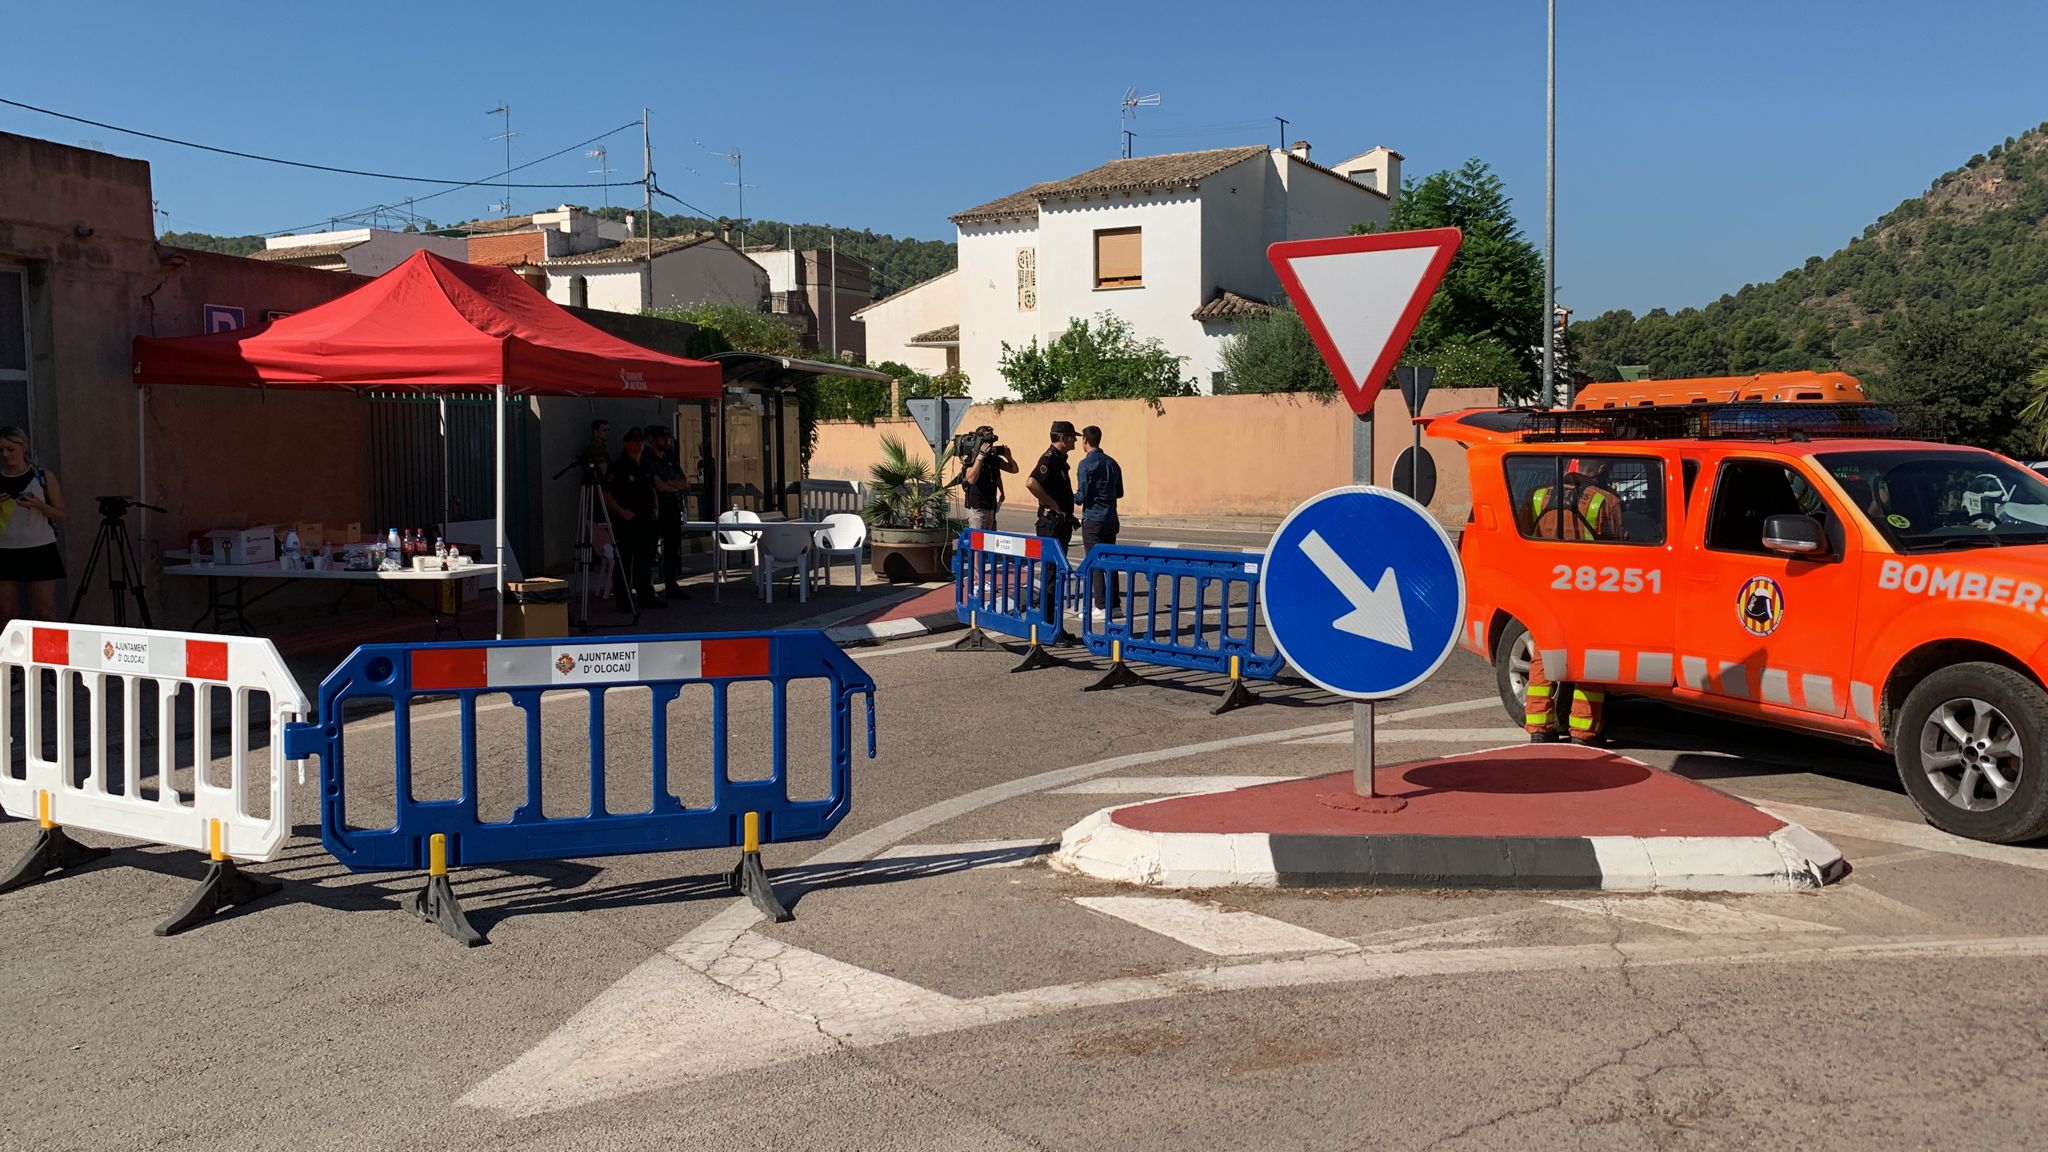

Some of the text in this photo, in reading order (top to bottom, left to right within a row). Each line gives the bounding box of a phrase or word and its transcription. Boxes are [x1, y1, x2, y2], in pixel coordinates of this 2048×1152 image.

[1551, 564, 1661, 594] 28251
[115, 642, 147, 652] AJUNTAMENT
[578, 651, 636, 662] AJUNTAMENT
